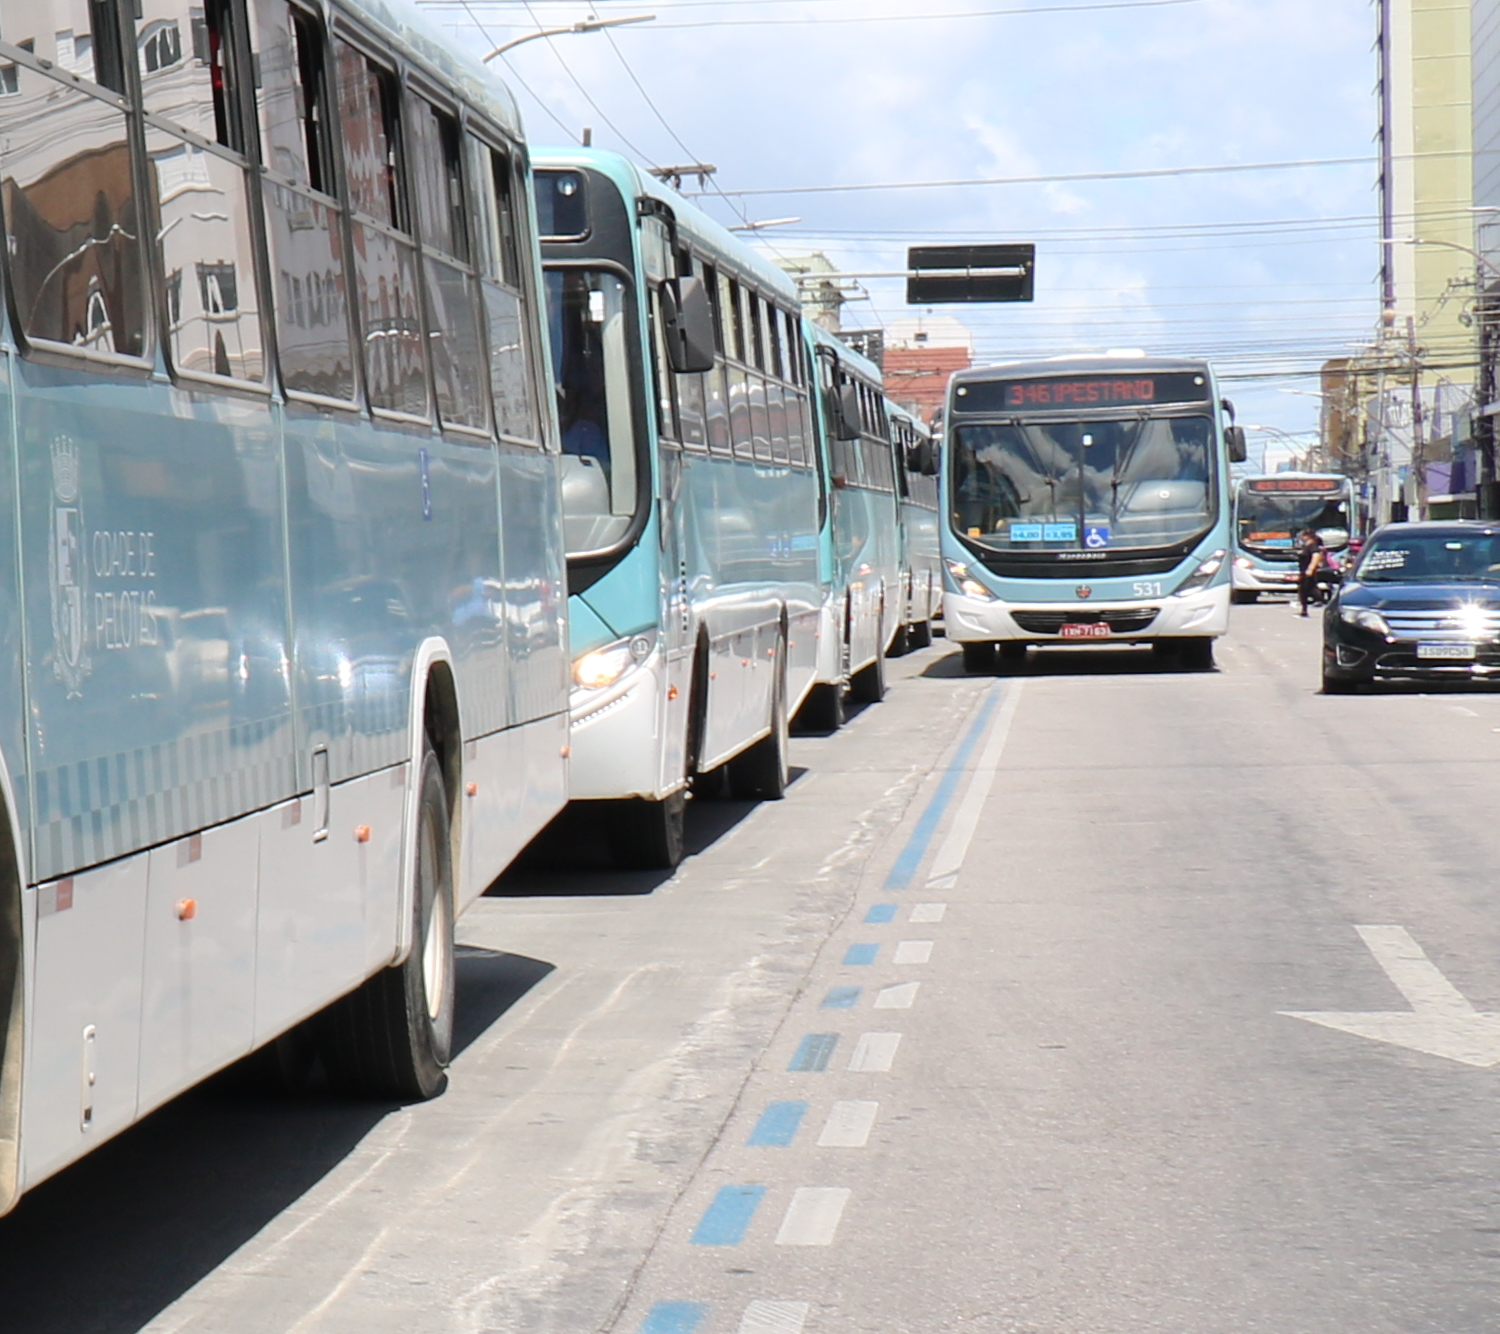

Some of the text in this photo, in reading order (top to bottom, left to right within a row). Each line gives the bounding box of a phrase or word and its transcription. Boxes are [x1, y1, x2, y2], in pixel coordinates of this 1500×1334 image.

[92, 530, 156, 577] CIDADE DE
[1132, 582, 1161, 597] 531
[94, 589, 158, 650] PELOTAS
